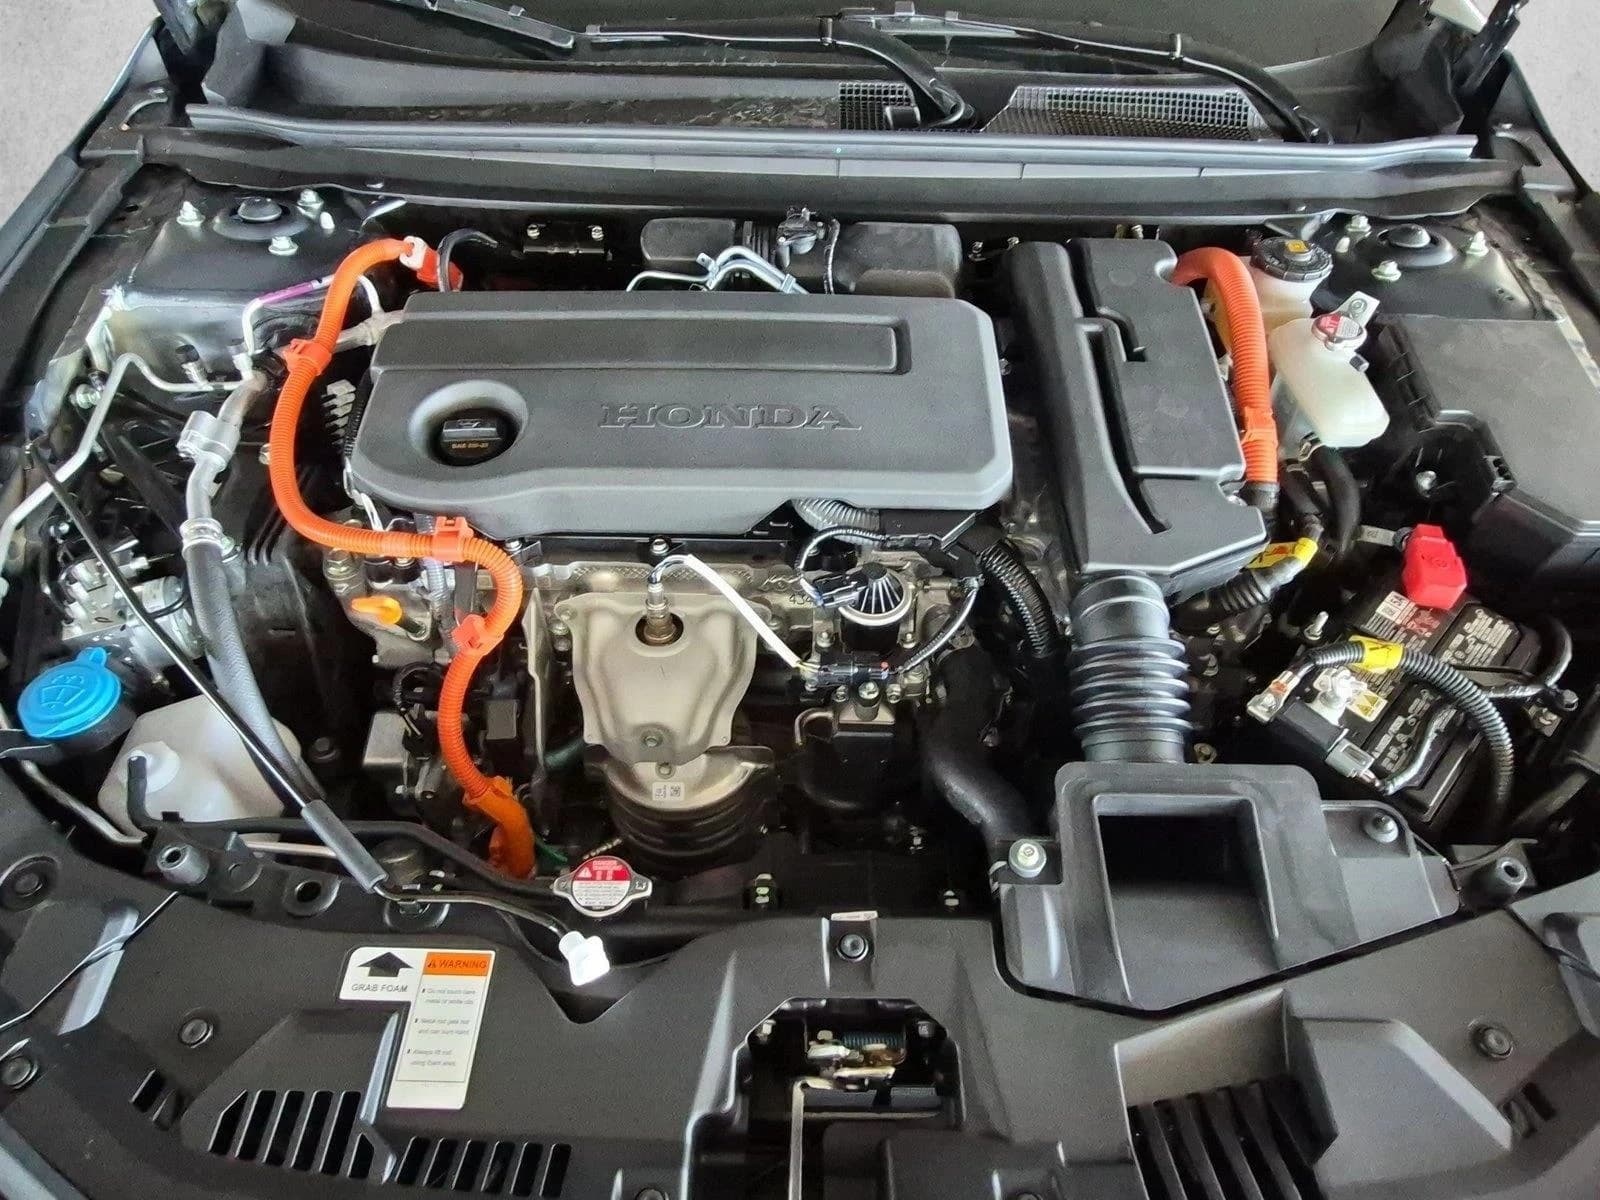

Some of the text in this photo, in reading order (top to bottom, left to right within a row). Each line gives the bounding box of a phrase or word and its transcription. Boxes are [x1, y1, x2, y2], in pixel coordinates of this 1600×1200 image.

[599, 403, 862, 431] HONDA
[439, 960, 487, 969] WARNING
[351, 984, 409, 993] GRAB FOAM
